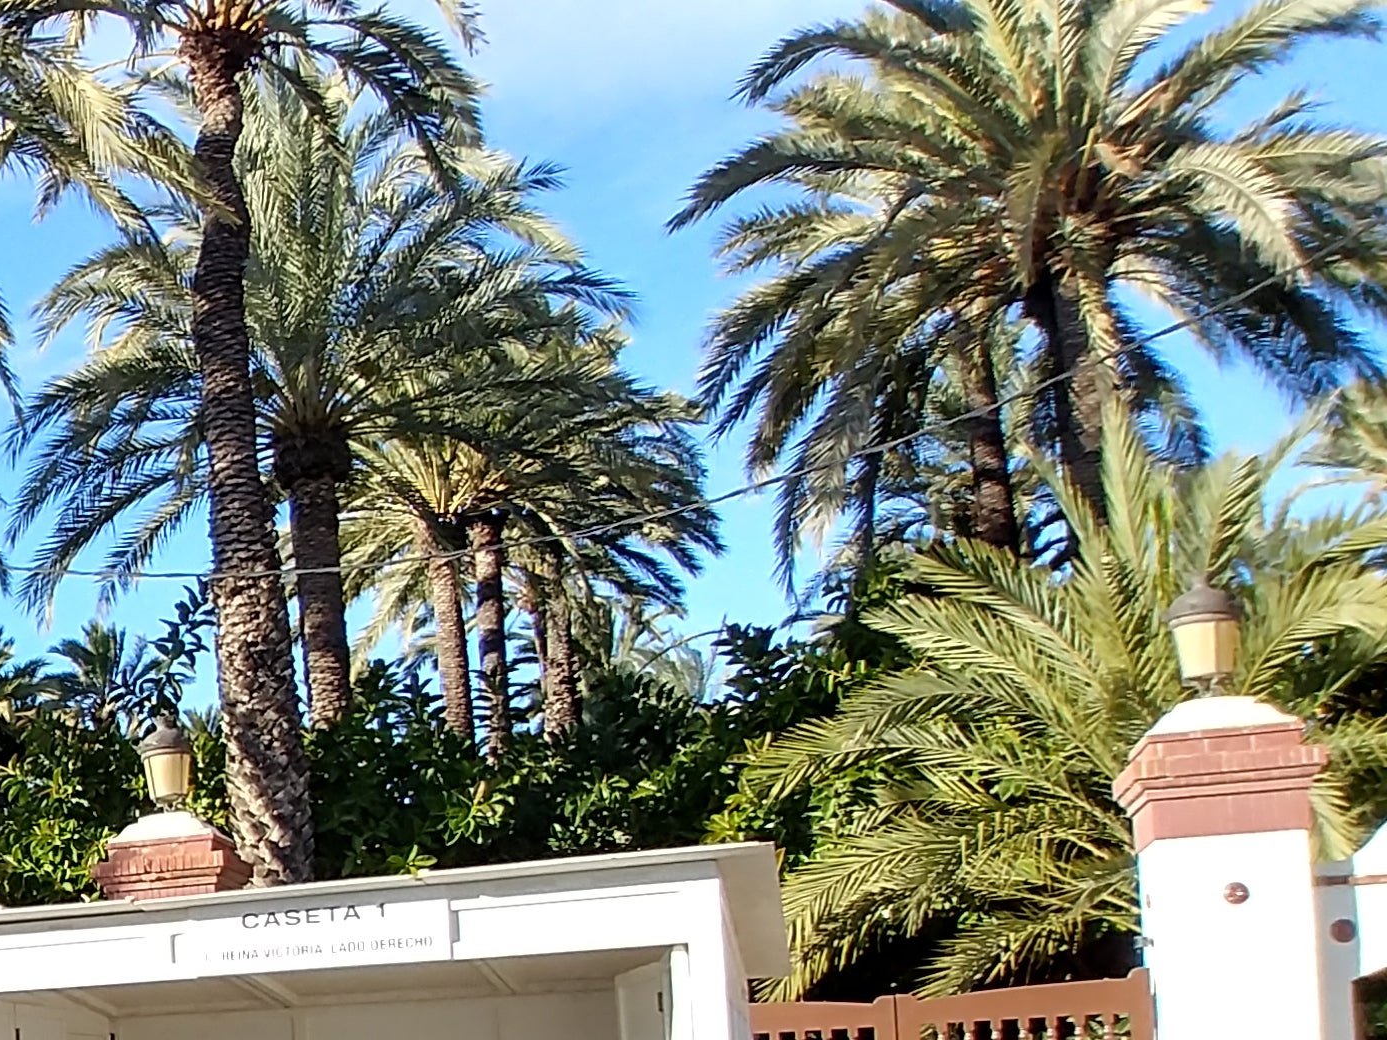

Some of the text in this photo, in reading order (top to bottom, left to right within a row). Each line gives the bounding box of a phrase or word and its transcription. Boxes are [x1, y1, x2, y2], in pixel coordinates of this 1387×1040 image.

[241, 903, 360, 929] CASETA
[222, 948, 259, 961] REINA
[264, 944, 323, 958] VICTORIA
[331, 939, 365, 954] LADO
[370, 936, 433, 951] DERECHO
